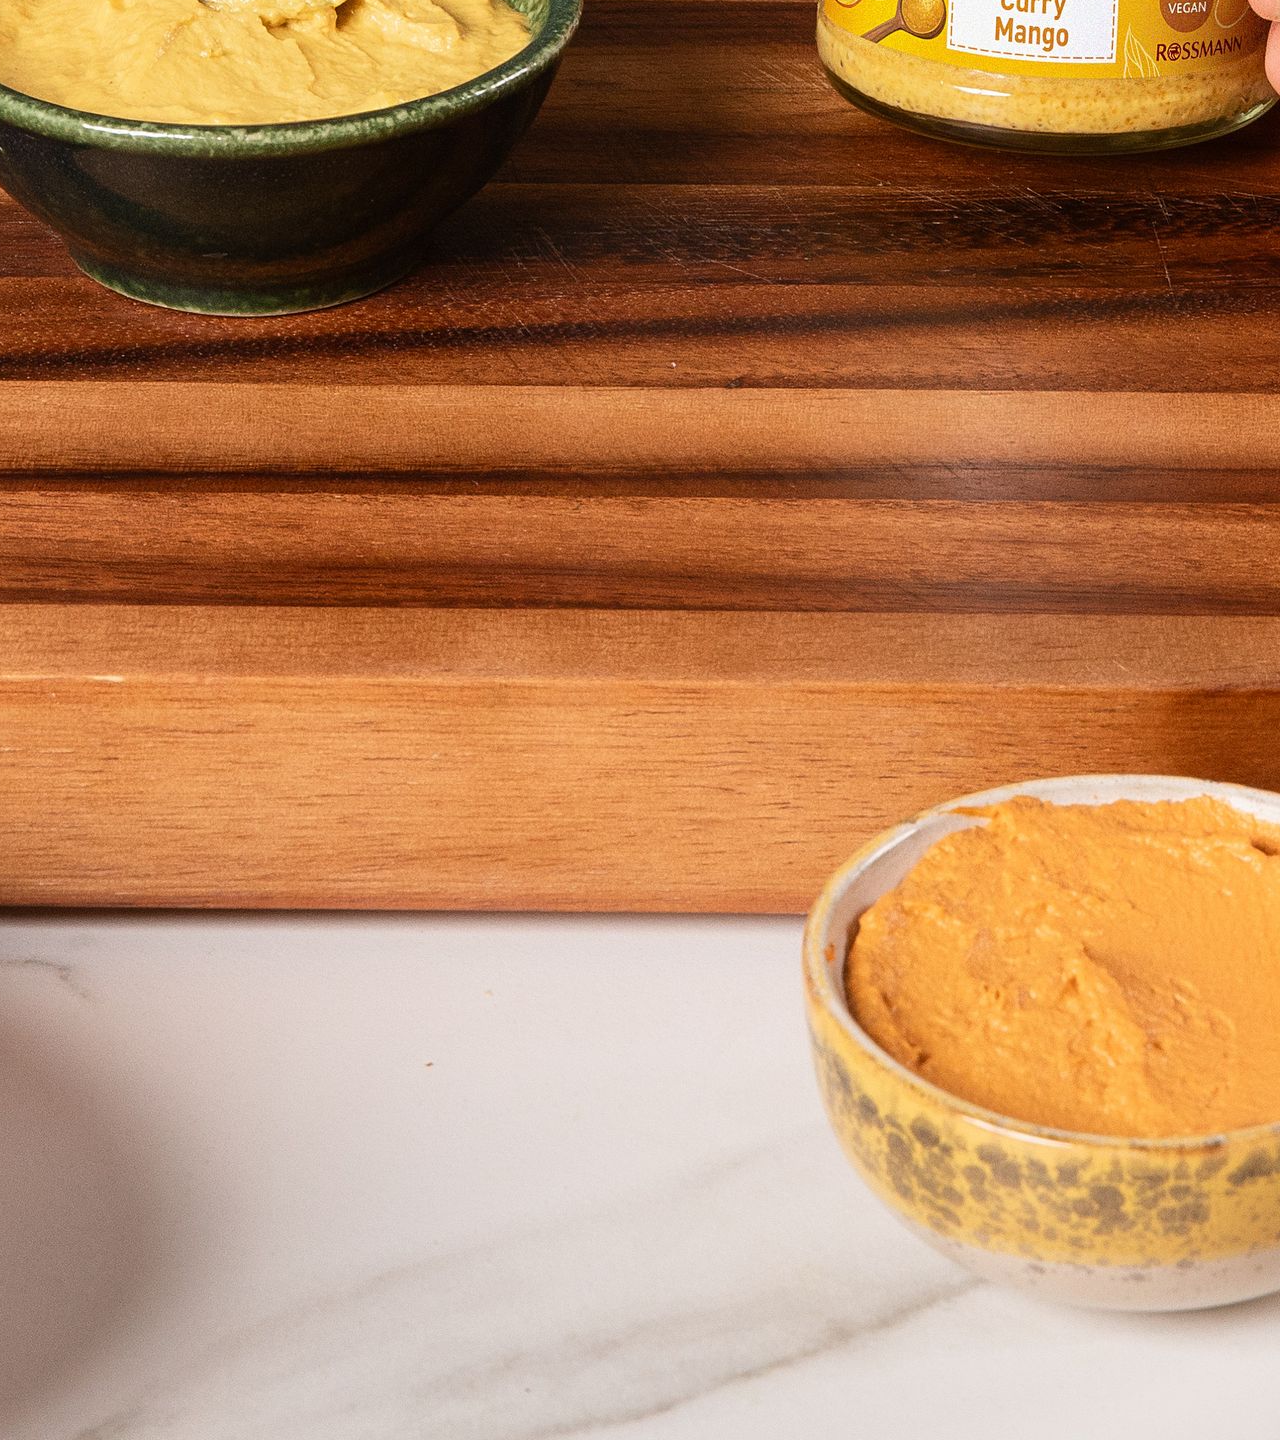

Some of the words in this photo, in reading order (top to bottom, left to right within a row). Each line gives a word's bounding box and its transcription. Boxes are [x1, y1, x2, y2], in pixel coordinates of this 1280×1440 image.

[1168, 1, 1207, 14] VEGAN
[994, 16, 1069, 52] Mango
[1156, 35, 1243, 62] ROSSMANN
